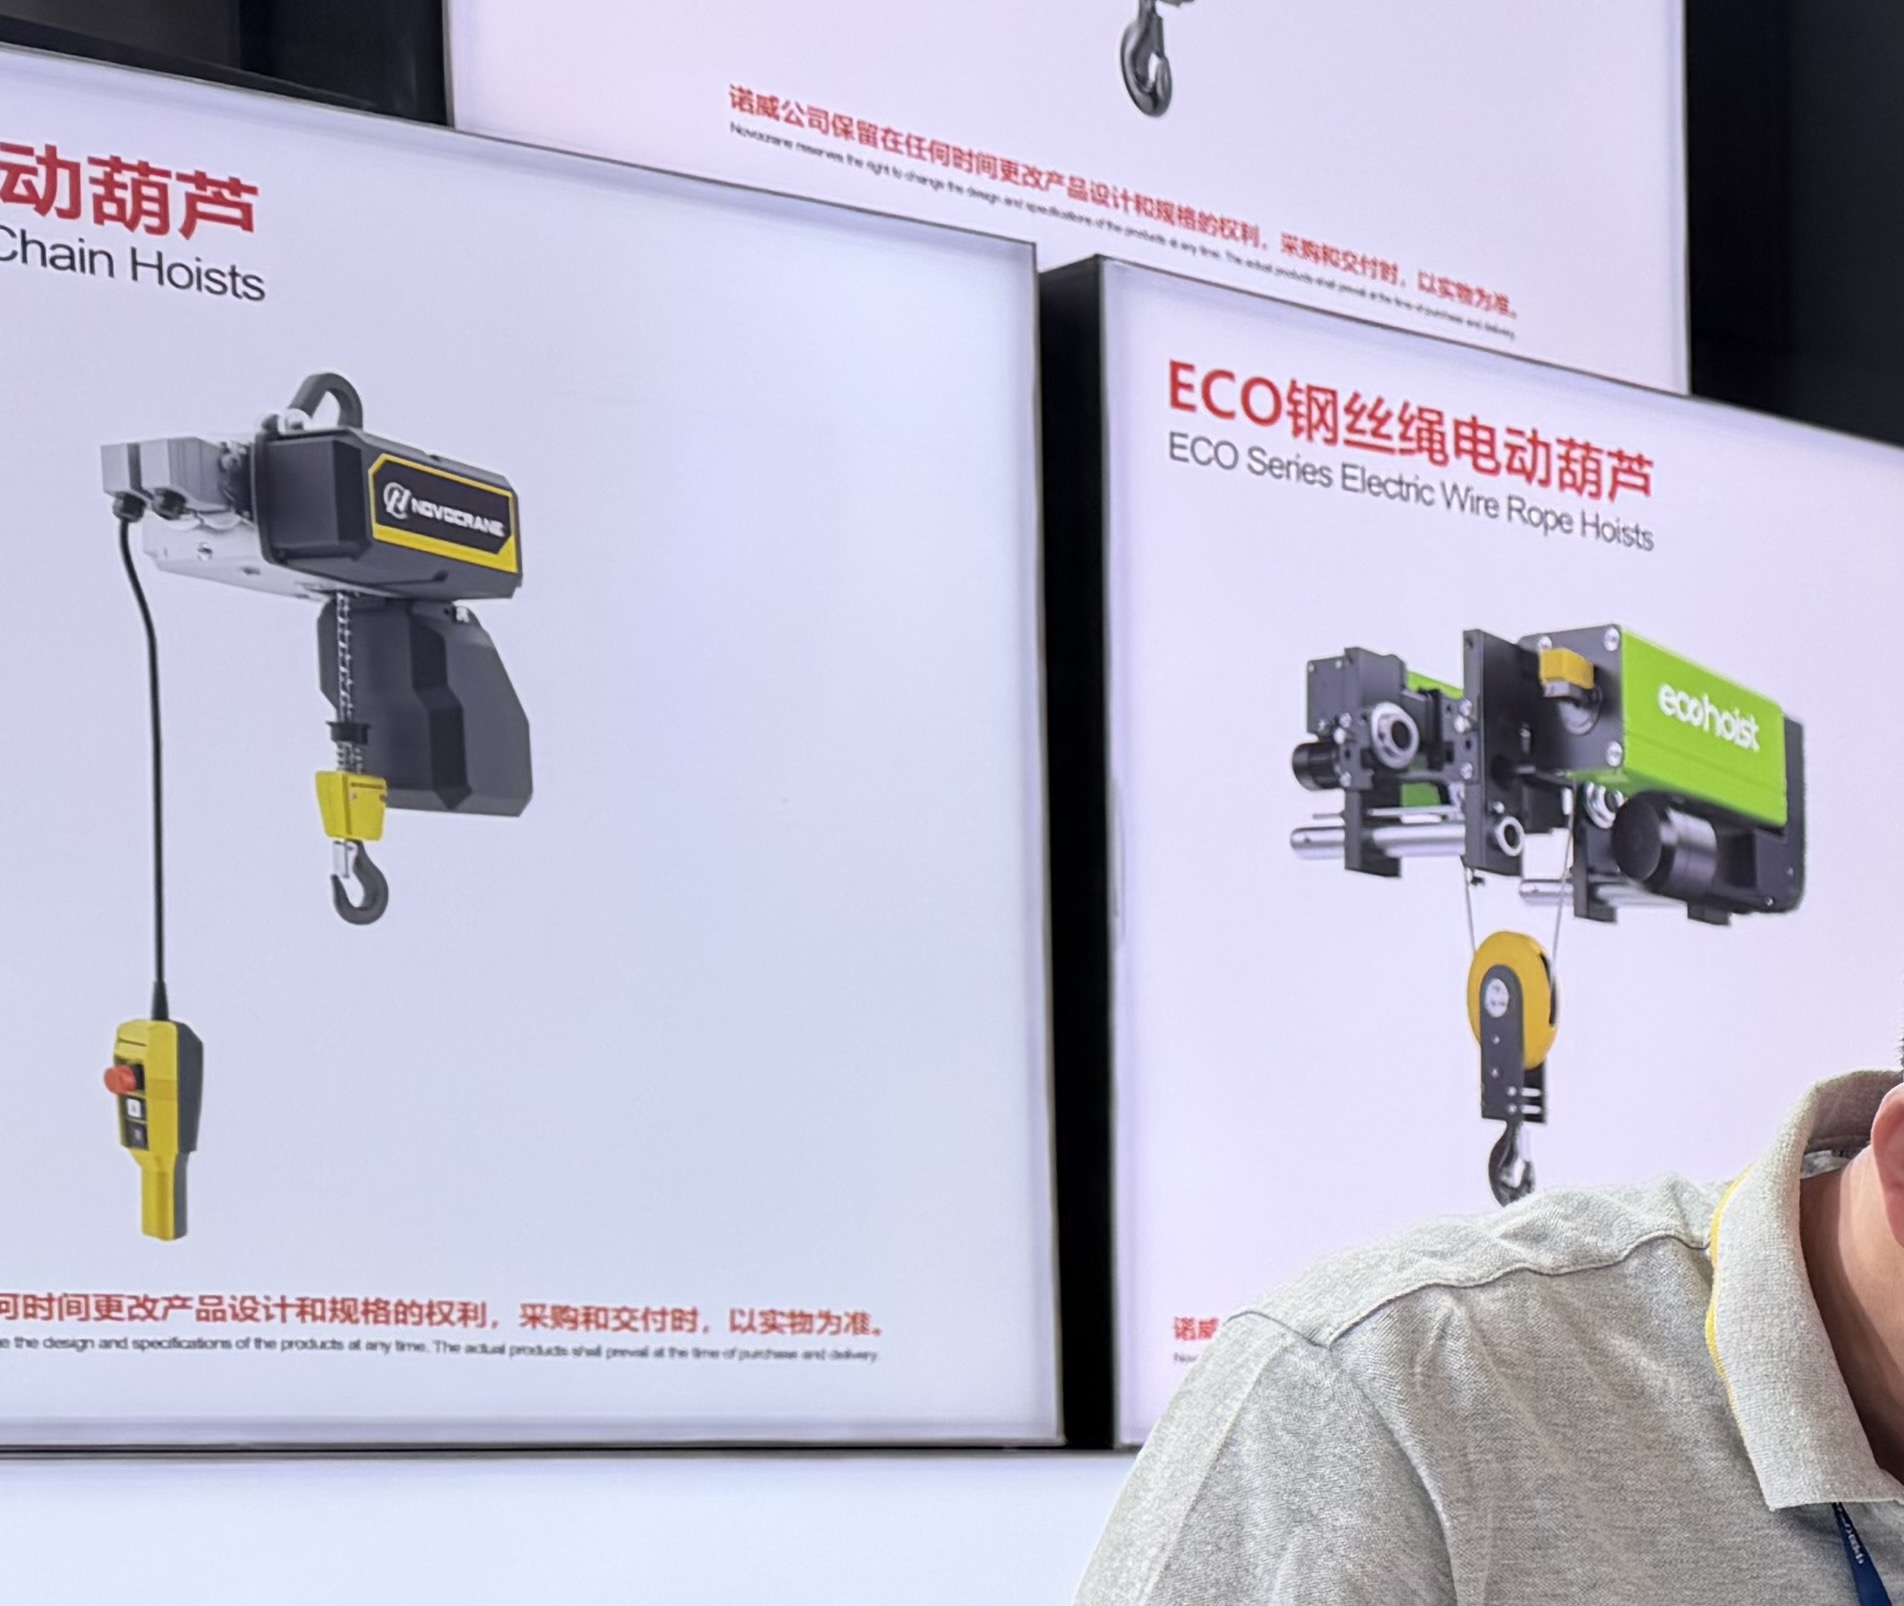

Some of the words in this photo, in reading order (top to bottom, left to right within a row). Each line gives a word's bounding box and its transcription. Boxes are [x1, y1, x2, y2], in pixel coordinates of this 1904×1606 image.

[131, 246, 266, 302] Hoists
[1169, 359, 1654, 503] ECO钢丝绳电动葫芦
[1169, 430, 1239, 471] ECO
[1247, 446, 1333, 488] Series
[1341, 463, 1436, 508] Electric
[1441, 480, 1500, 519] Wire
[1507, 493, 1573, 538] Rope
[1581, 511, 1655, 552] Hoists
[1658, 680, 1762, 755] ecohoist
